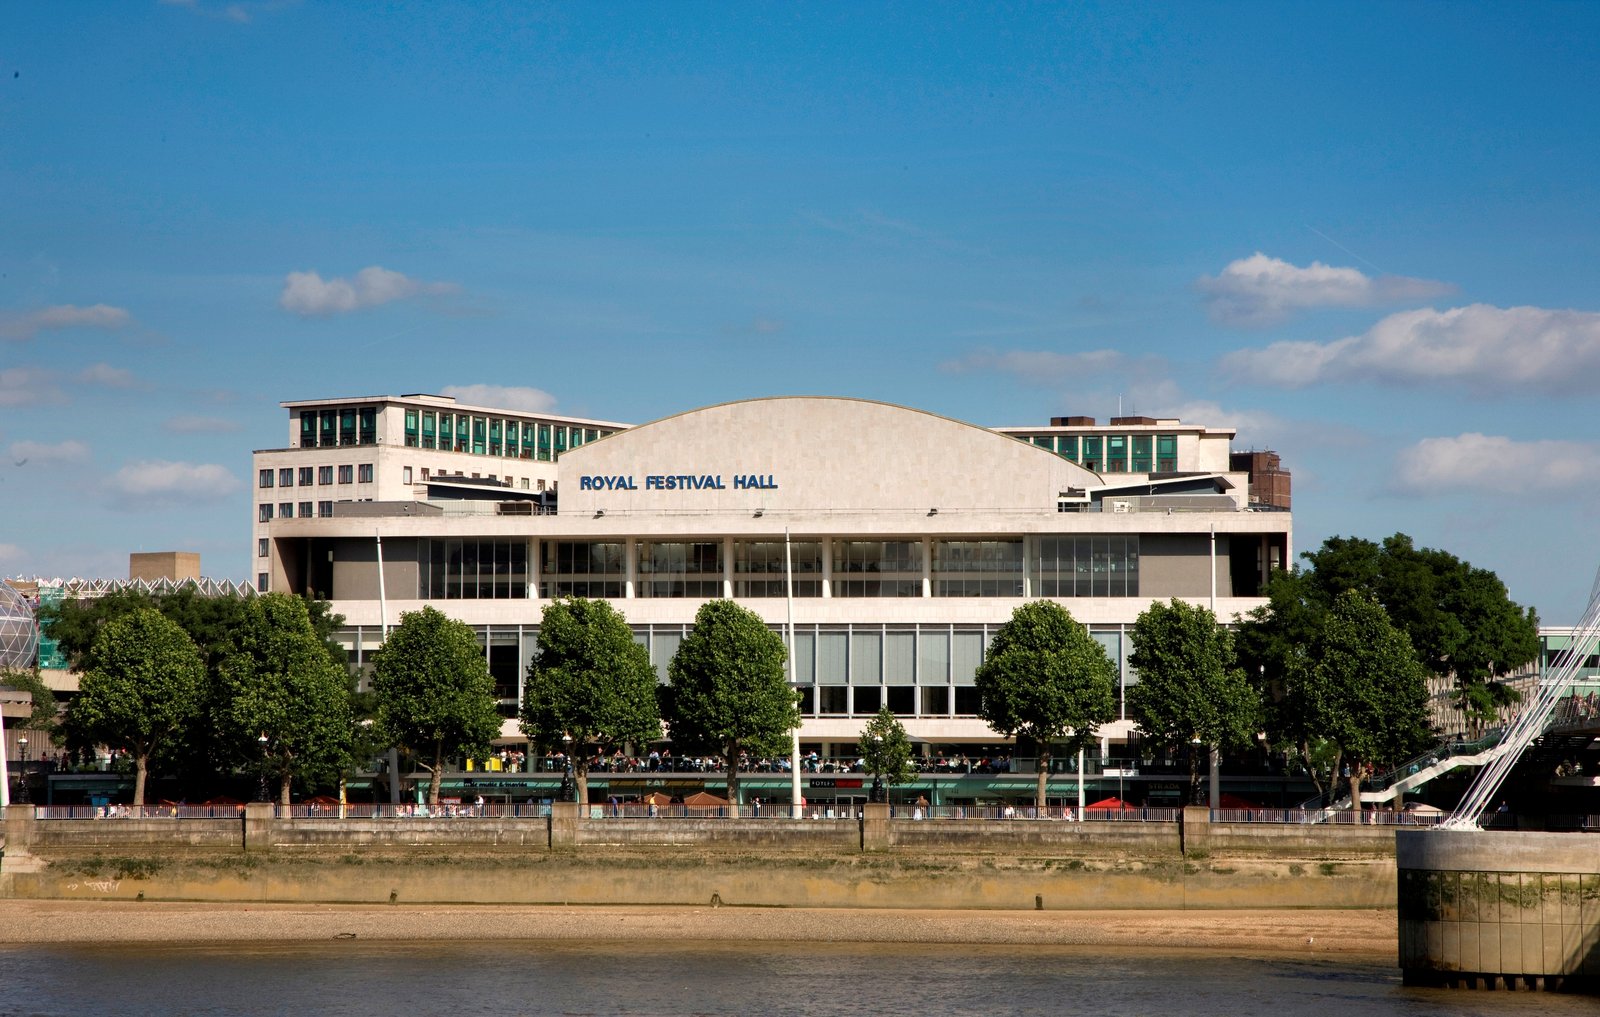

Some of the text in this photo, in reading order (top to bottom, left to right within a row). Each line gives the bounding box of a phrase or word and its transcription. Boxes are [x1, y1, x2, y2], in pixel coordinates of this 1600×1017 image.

[580, 474, 778, 490] ROYAL FESTIVAL HALL
